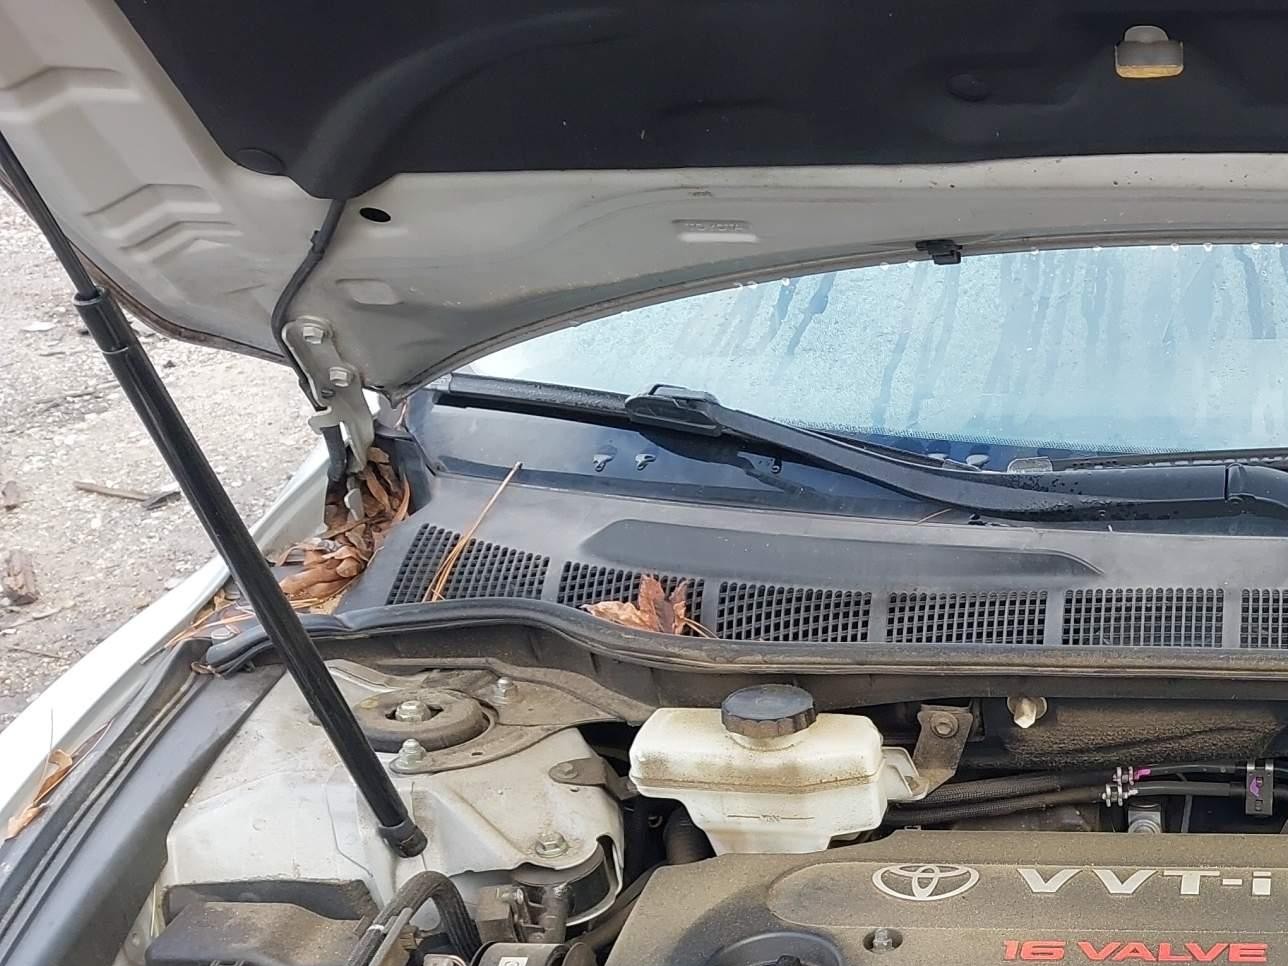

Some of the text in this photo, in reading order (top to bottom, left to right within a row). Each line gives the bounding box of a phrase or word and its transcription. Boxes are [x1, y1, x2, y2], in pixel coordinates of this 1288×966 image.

[1016, 867, 1272, 897] VVT-i
[1003, 939, 1269, 963] 16 VALVE
